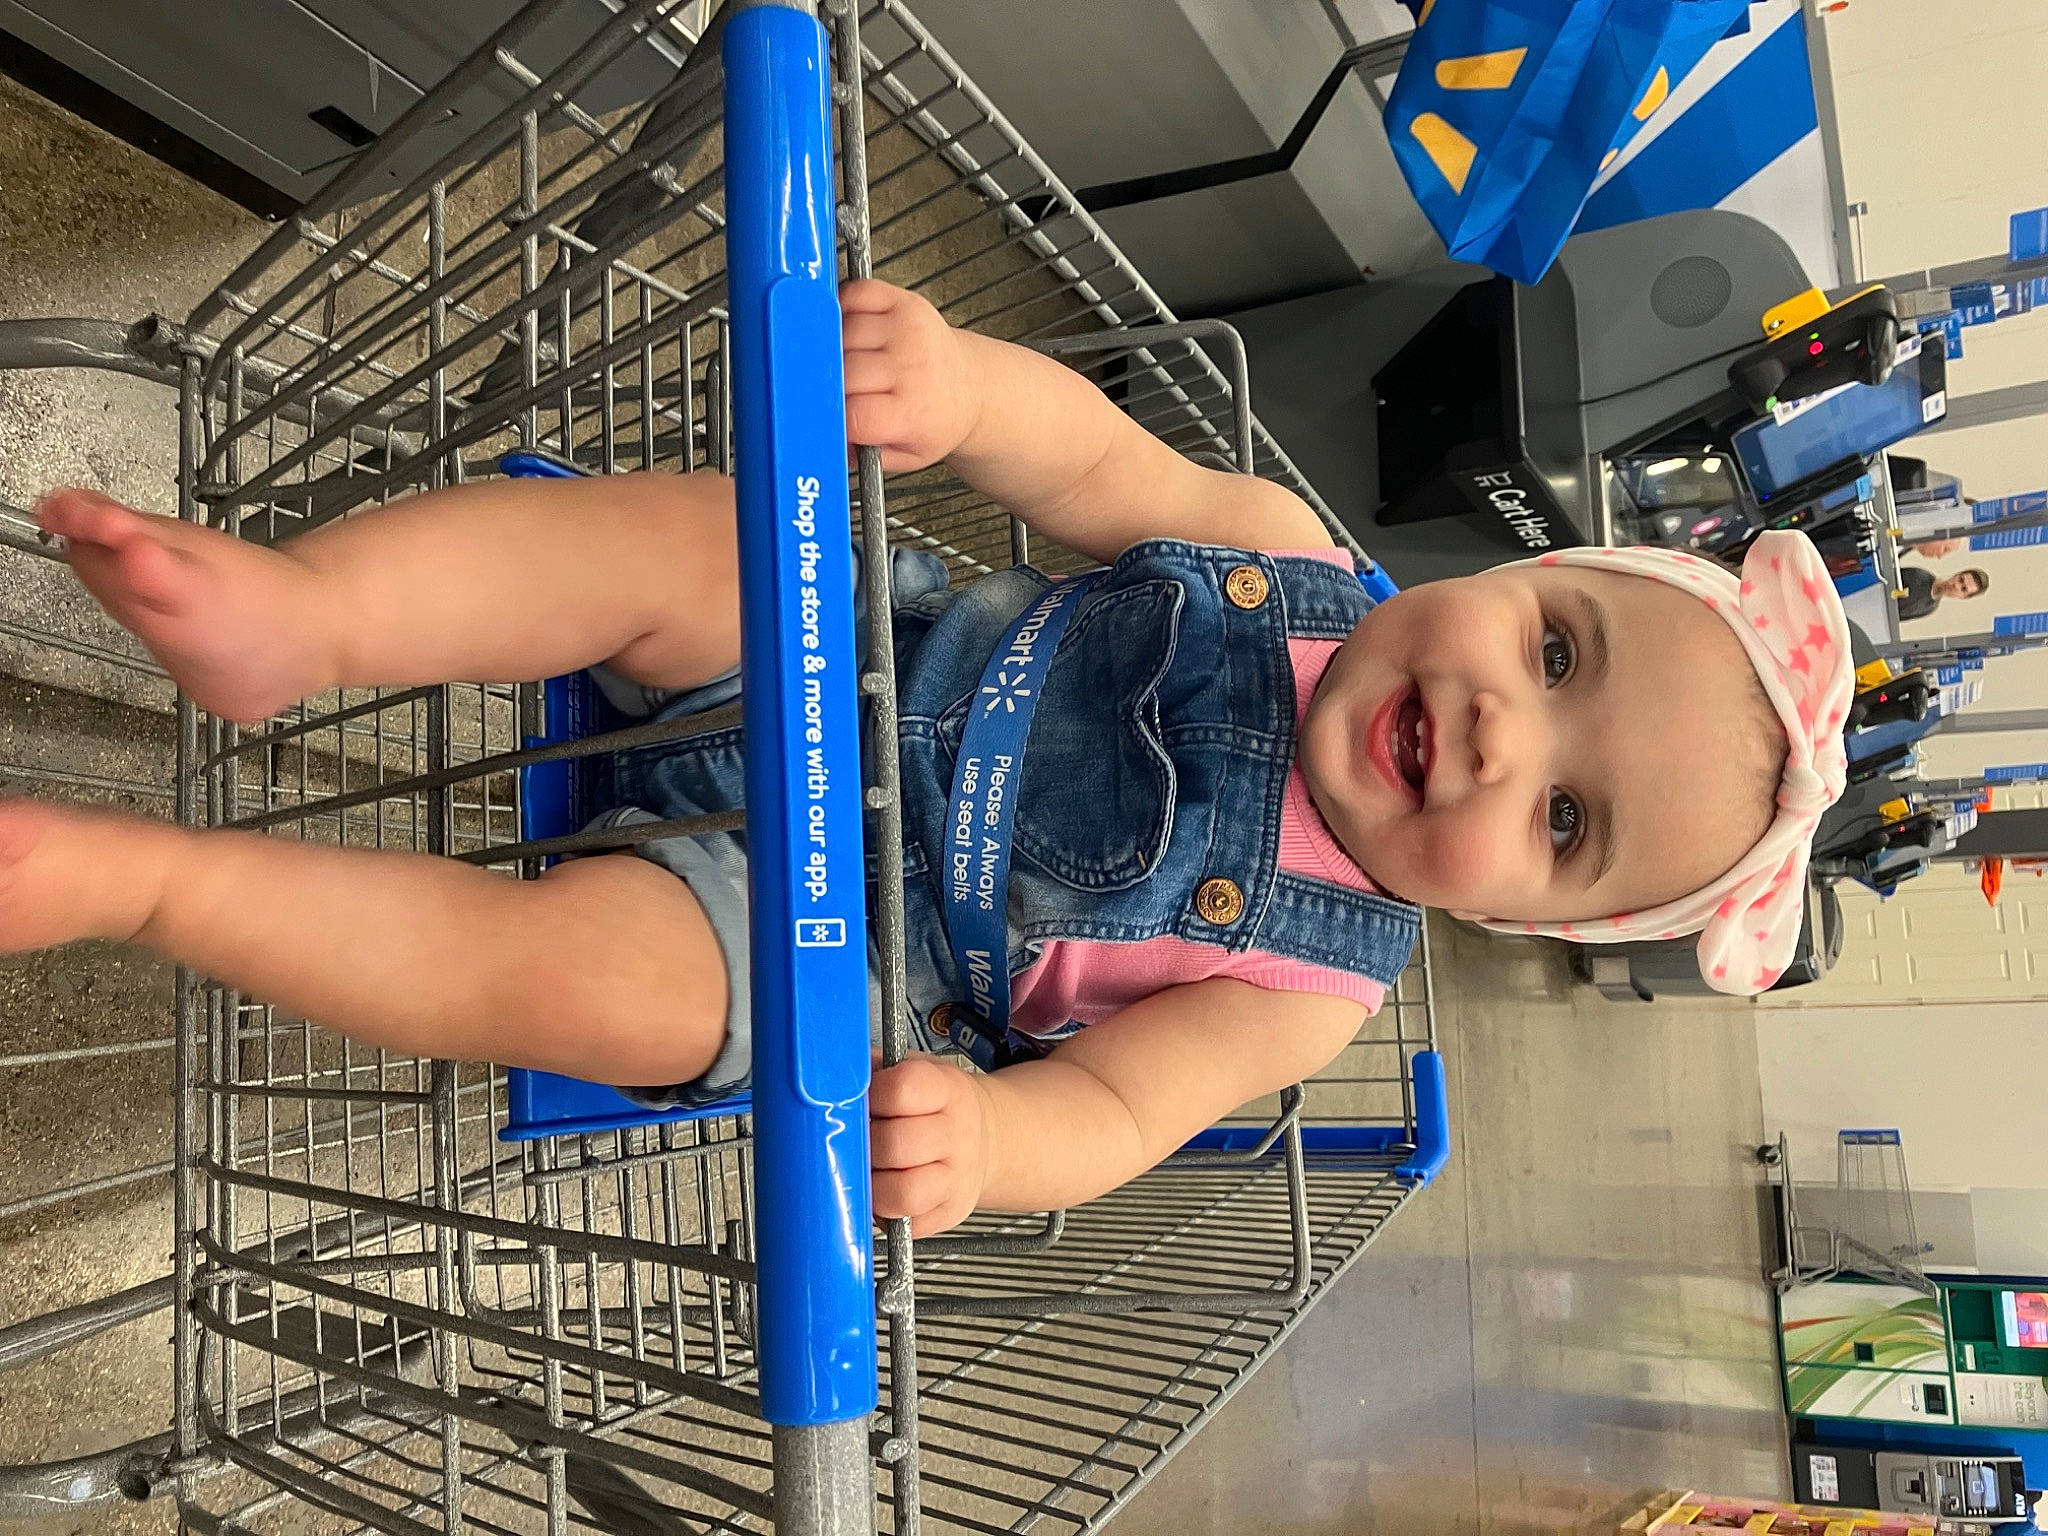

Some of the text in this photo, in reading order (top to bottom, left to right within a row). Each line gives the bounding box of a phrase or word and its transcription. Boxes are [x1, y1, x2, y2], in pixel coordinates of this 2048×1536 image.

[1488, 489, 1551, 548] Cart Here
[1003, 582, 1079, 667] Walmart
[792, 476, 830, 903] Shop the store & more with our app.
[953, 757, 981, 903] use seat belts.
[977, 754, 1013, 910] Please: Always
[2013, 1382, 2024, 1400] the
[2024, 1382, 2040, 1421] Beyond
[2014, 1492, 2027, 1516] ATM
